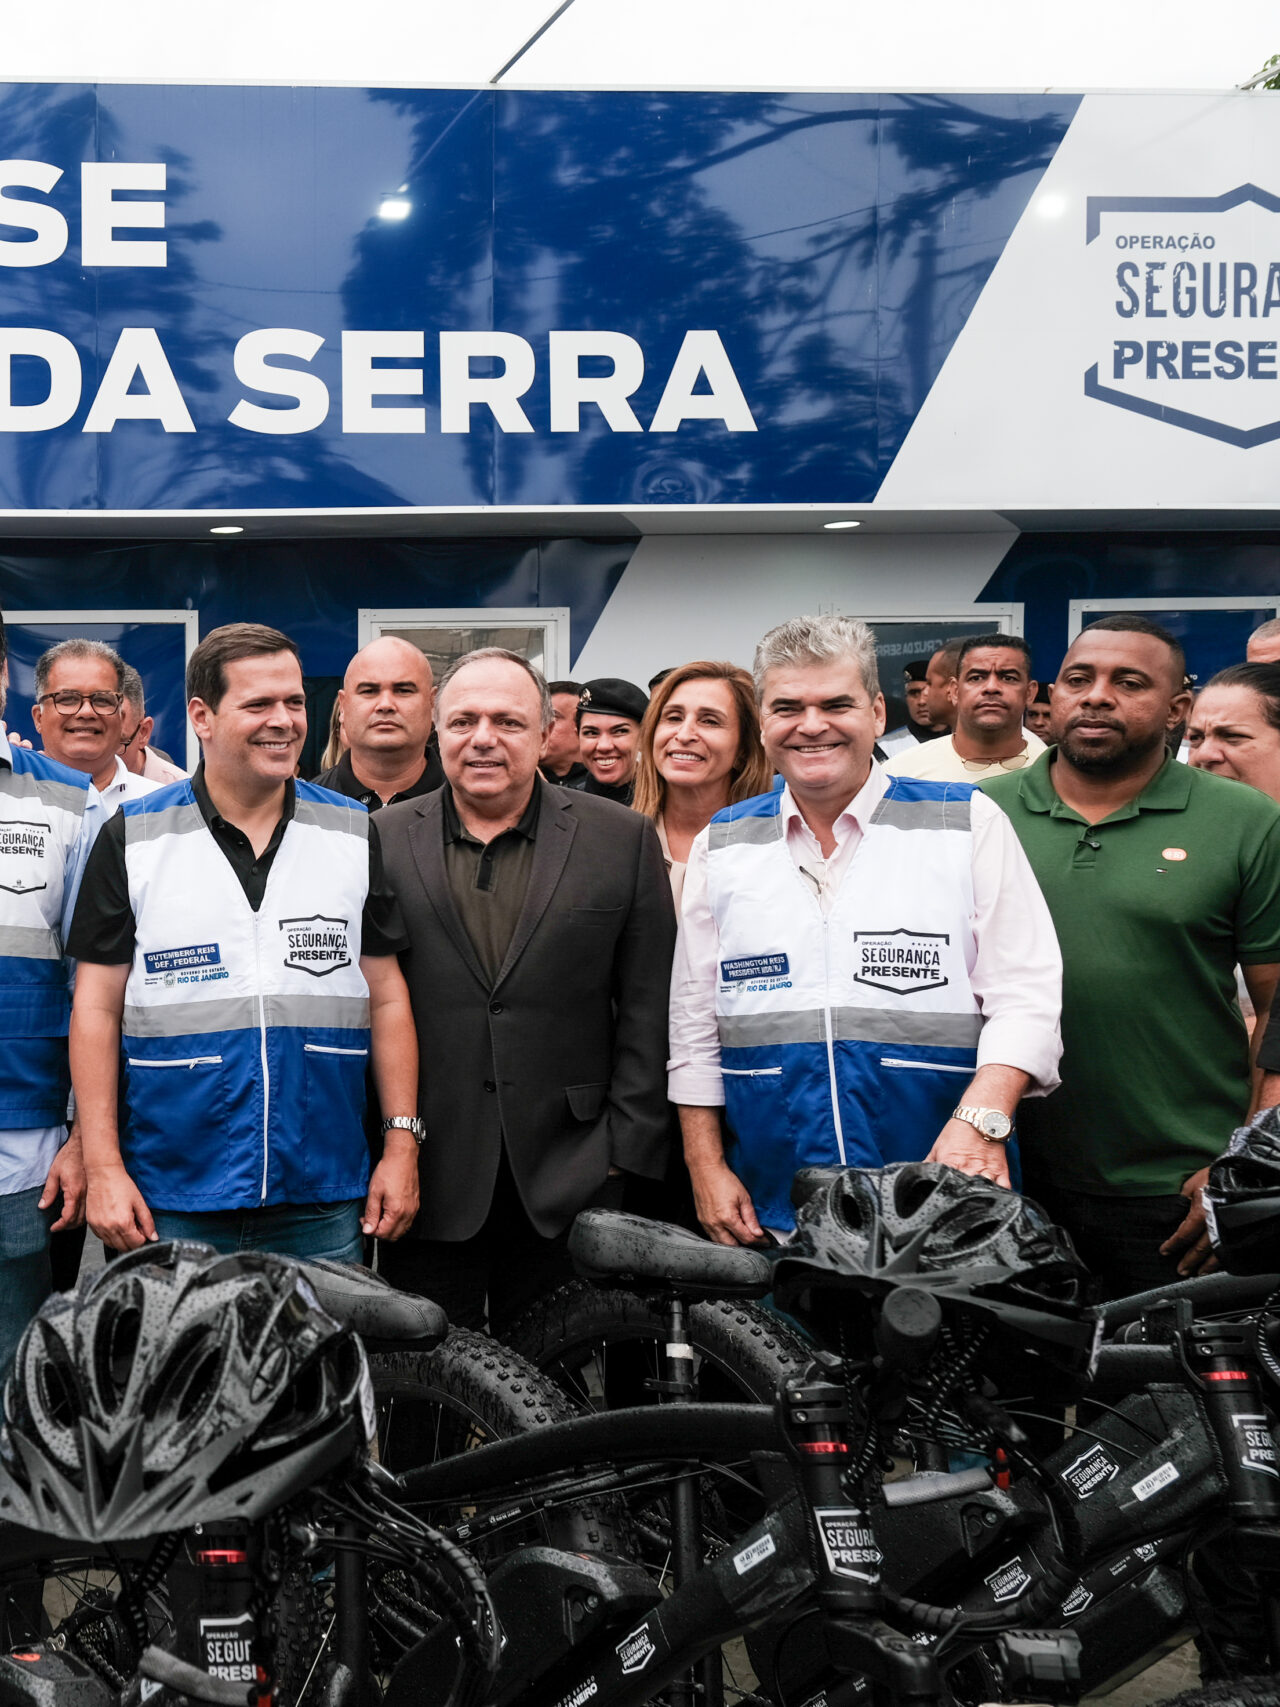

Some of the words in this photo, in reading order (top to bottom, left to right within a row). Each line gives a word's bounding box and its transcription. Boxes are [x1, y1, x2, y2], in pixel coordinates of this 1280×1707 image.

[1115, 232, 1216, 253] OPERAÇÃO
[1113, 340, 1278, 380] PRESE
[227, 328, 759, 435] SERRA
[288, 933, 348, 950] SEGURANÇA
[147, 949, 196, 962] GUTEMBERG
[197, 946, 216, 954] REIS
[174, 955, 211, 967] FEDERAL
[290, 950, 347, 961] PRESENTE
[723, 958, 769, 971] WASHINGTON
[861, 947, 940, 968] SEGURANÇA
[177, 976, 189, 984] RIO
[201, 971, 230, 981] JANEIRO
[861, 966, 940, 980] PRESENTE
[747, 984, 758, 992] RIO
[1071, 1455, 1109, 1487] SEGURANÇA
[1078, 1463, 1115, 1494] PRESENTE
[994, 1573, 1027, 1598] PRESENTE
[1063, 1591, 1090, 1613] PRESENTE
[623, 1643, 652, 1669] PRESENTE
